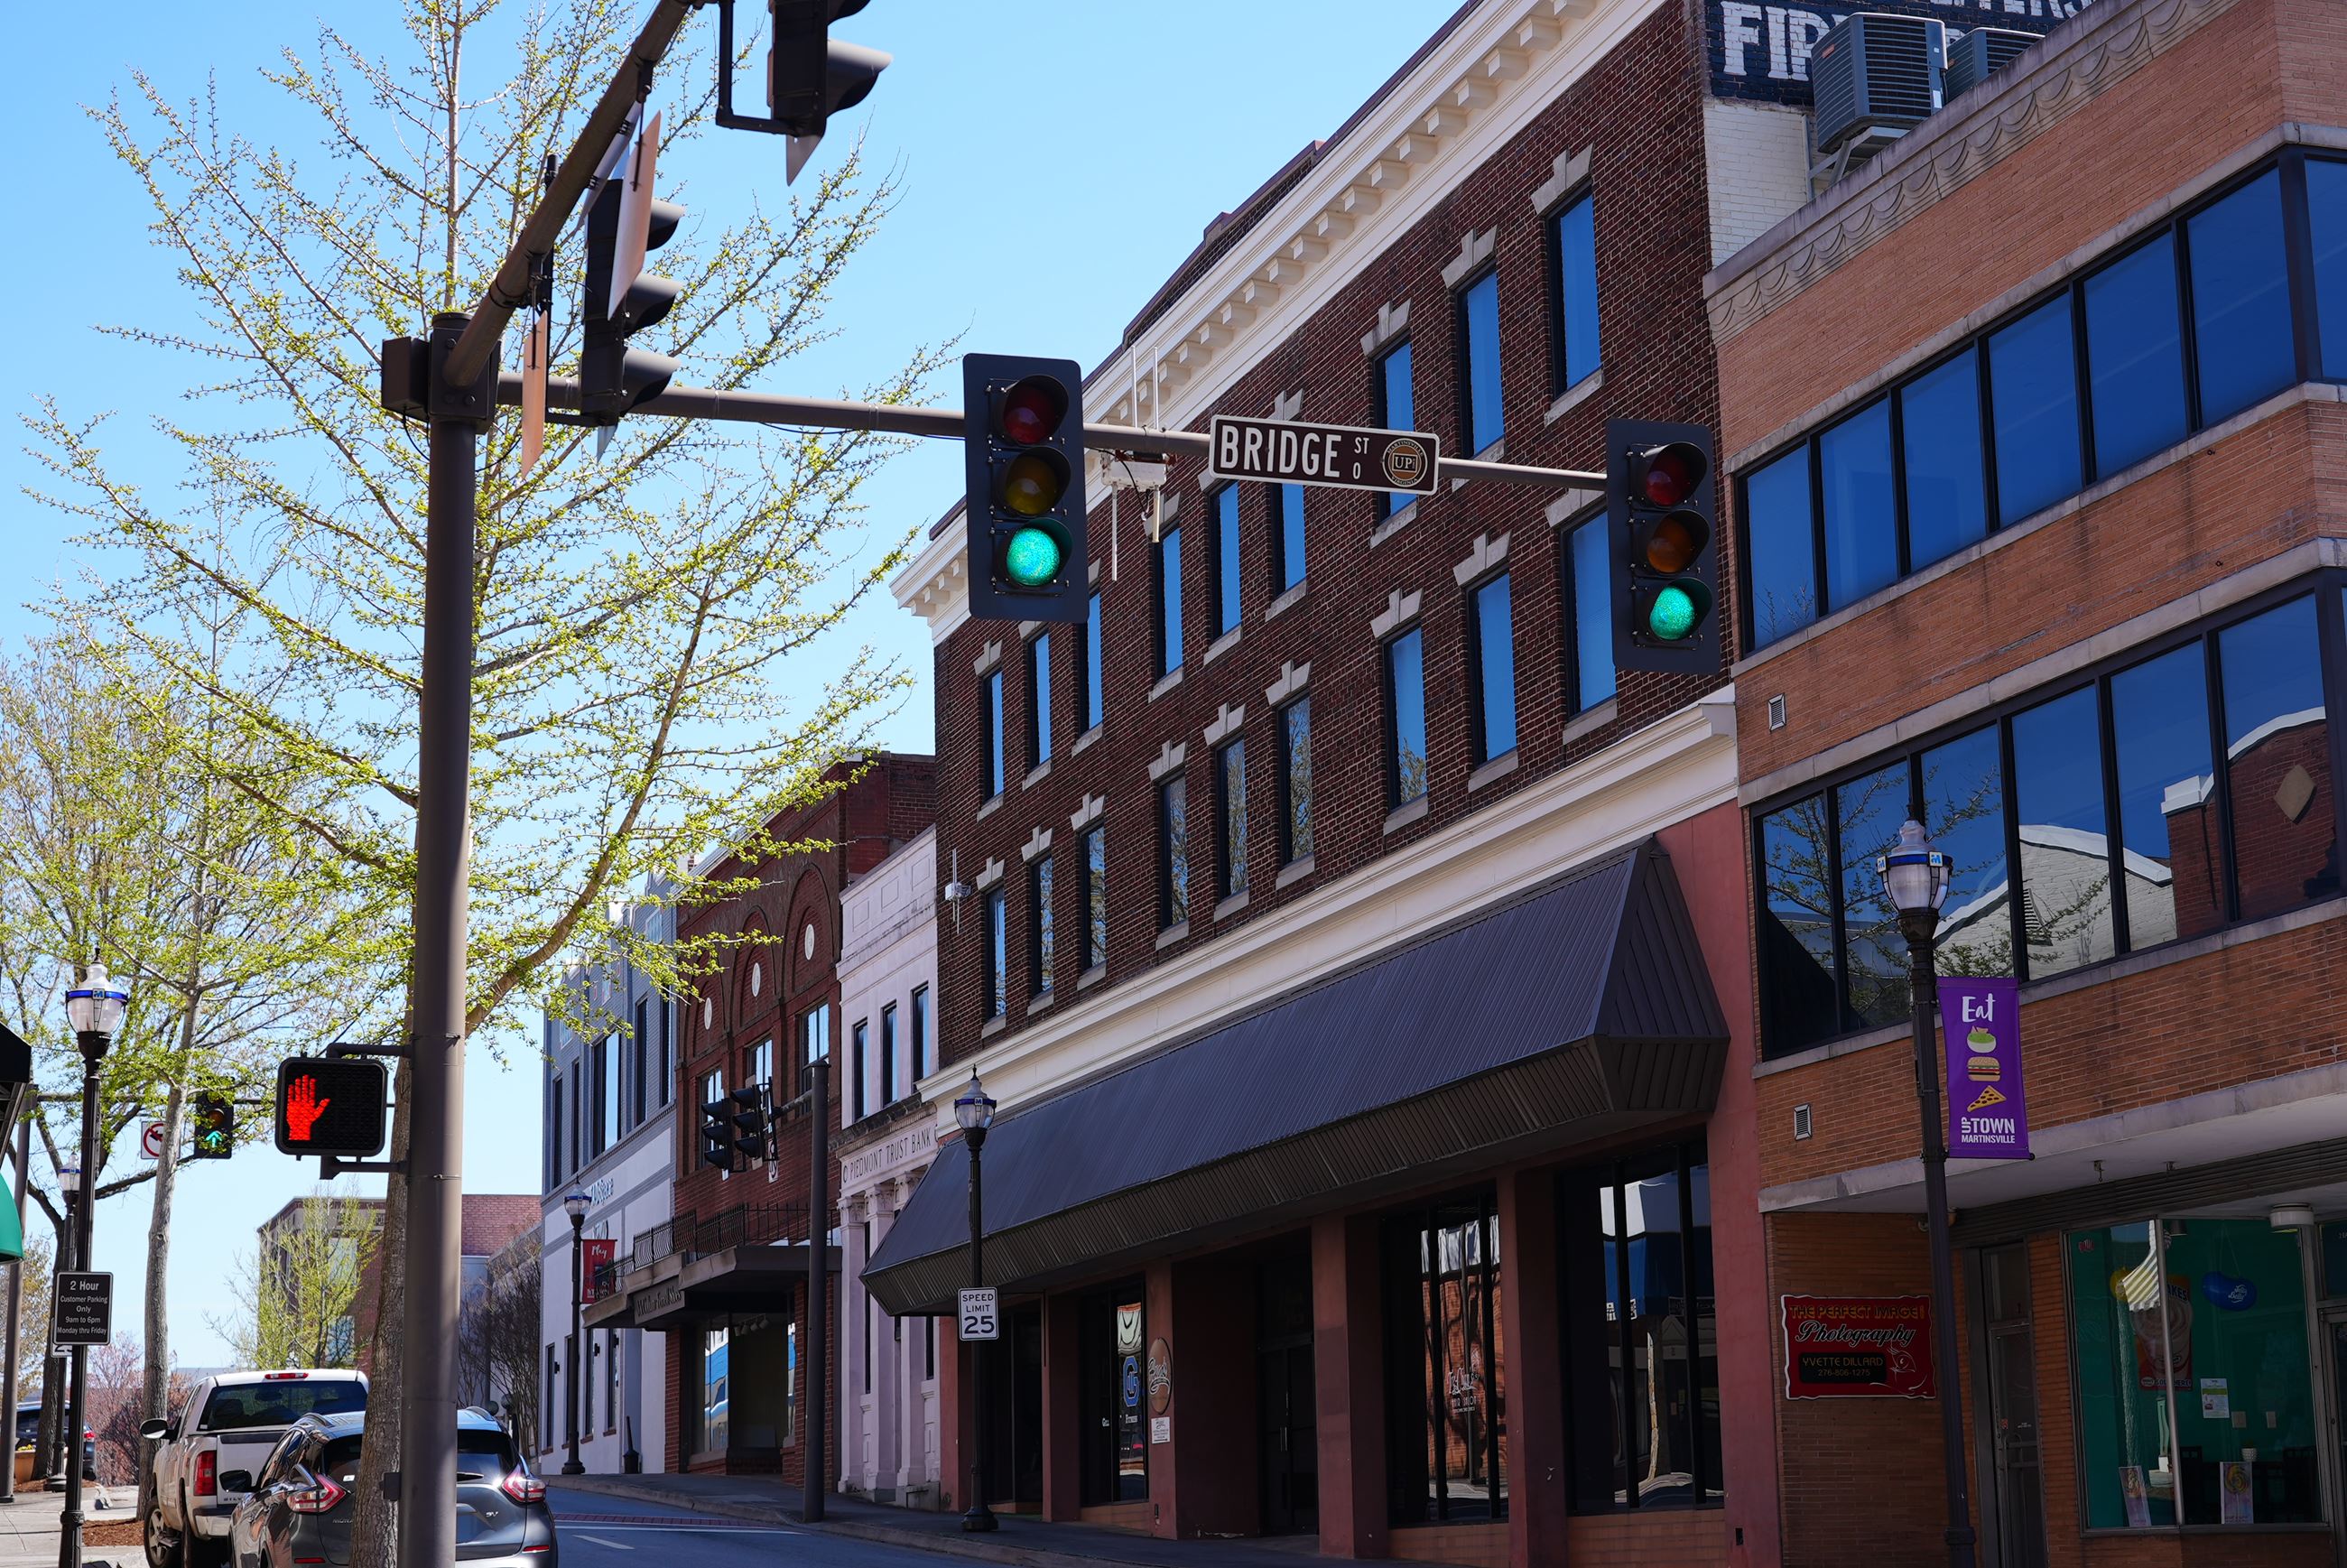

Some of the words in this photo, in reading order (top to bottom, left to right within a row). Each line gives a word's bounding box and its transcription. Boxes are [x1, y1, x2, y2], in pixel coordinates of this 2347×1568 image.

[1220, 425, 1342, 478] BRIDGE
[1354, 437, 1369, 455] ST
[1962, 993, 1996, 1023] Eat
[1962, 1135, 2016, 1144] MARTINSVILLE
[850, 1148, 882, 1181] PIEDMONT
[886, 1137, 908, 1164] TRUST
[912, 1127, 931, 1154] BANK
[591, 1244, 608, 1258] Play
[70, 1280, 77, 1291] 2
[79, 1280, 99, 1291] Hour
[87, 1295, 108, 1304] Parking
[962, 1294, 994, 1302] SPEED
[76, 1305, 92, 1313] Only
[966, 1304, 990, 1313] LIMIT
[1790, 1305, 1815, 1319] THE
[1818, 1305, 1871, 1319] PERFECT
[87, 1316, 101, 1324] 6pm
[964, 1315, 995, 1334] 25
[57, 1327, 79, 1335] Monday
[90, 1327, 107, 1335] Friday
[1795, 1320, 1916, 1348] Photography
[1802, 1357, 1841, 1367] YVETTE
[1843, 1357, 1884, 1367] DILLARD
